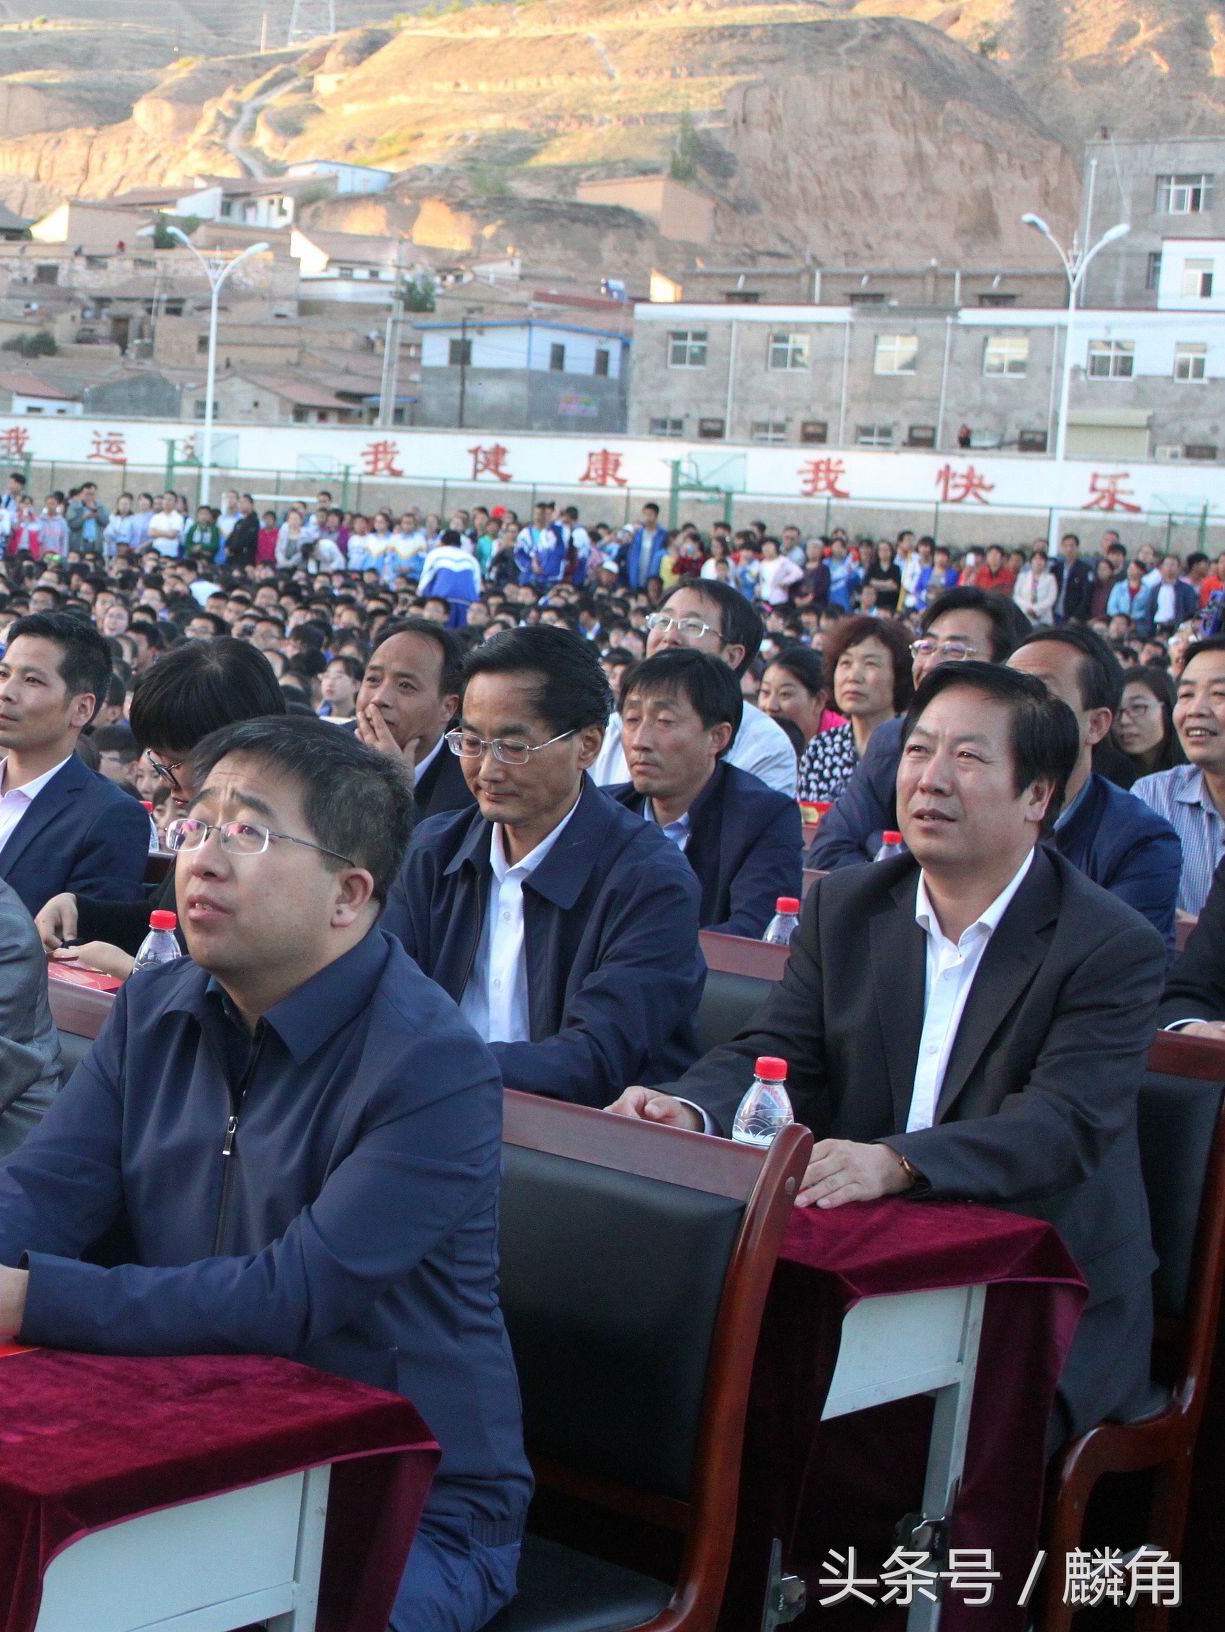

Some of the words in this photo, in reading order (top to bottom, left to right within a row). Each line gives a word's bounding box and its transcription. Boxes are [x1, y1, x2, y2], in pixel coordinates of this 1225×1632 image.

[361, 440, 628, 487] 我健康
[797, 457, 1142, 512] 我快乐
